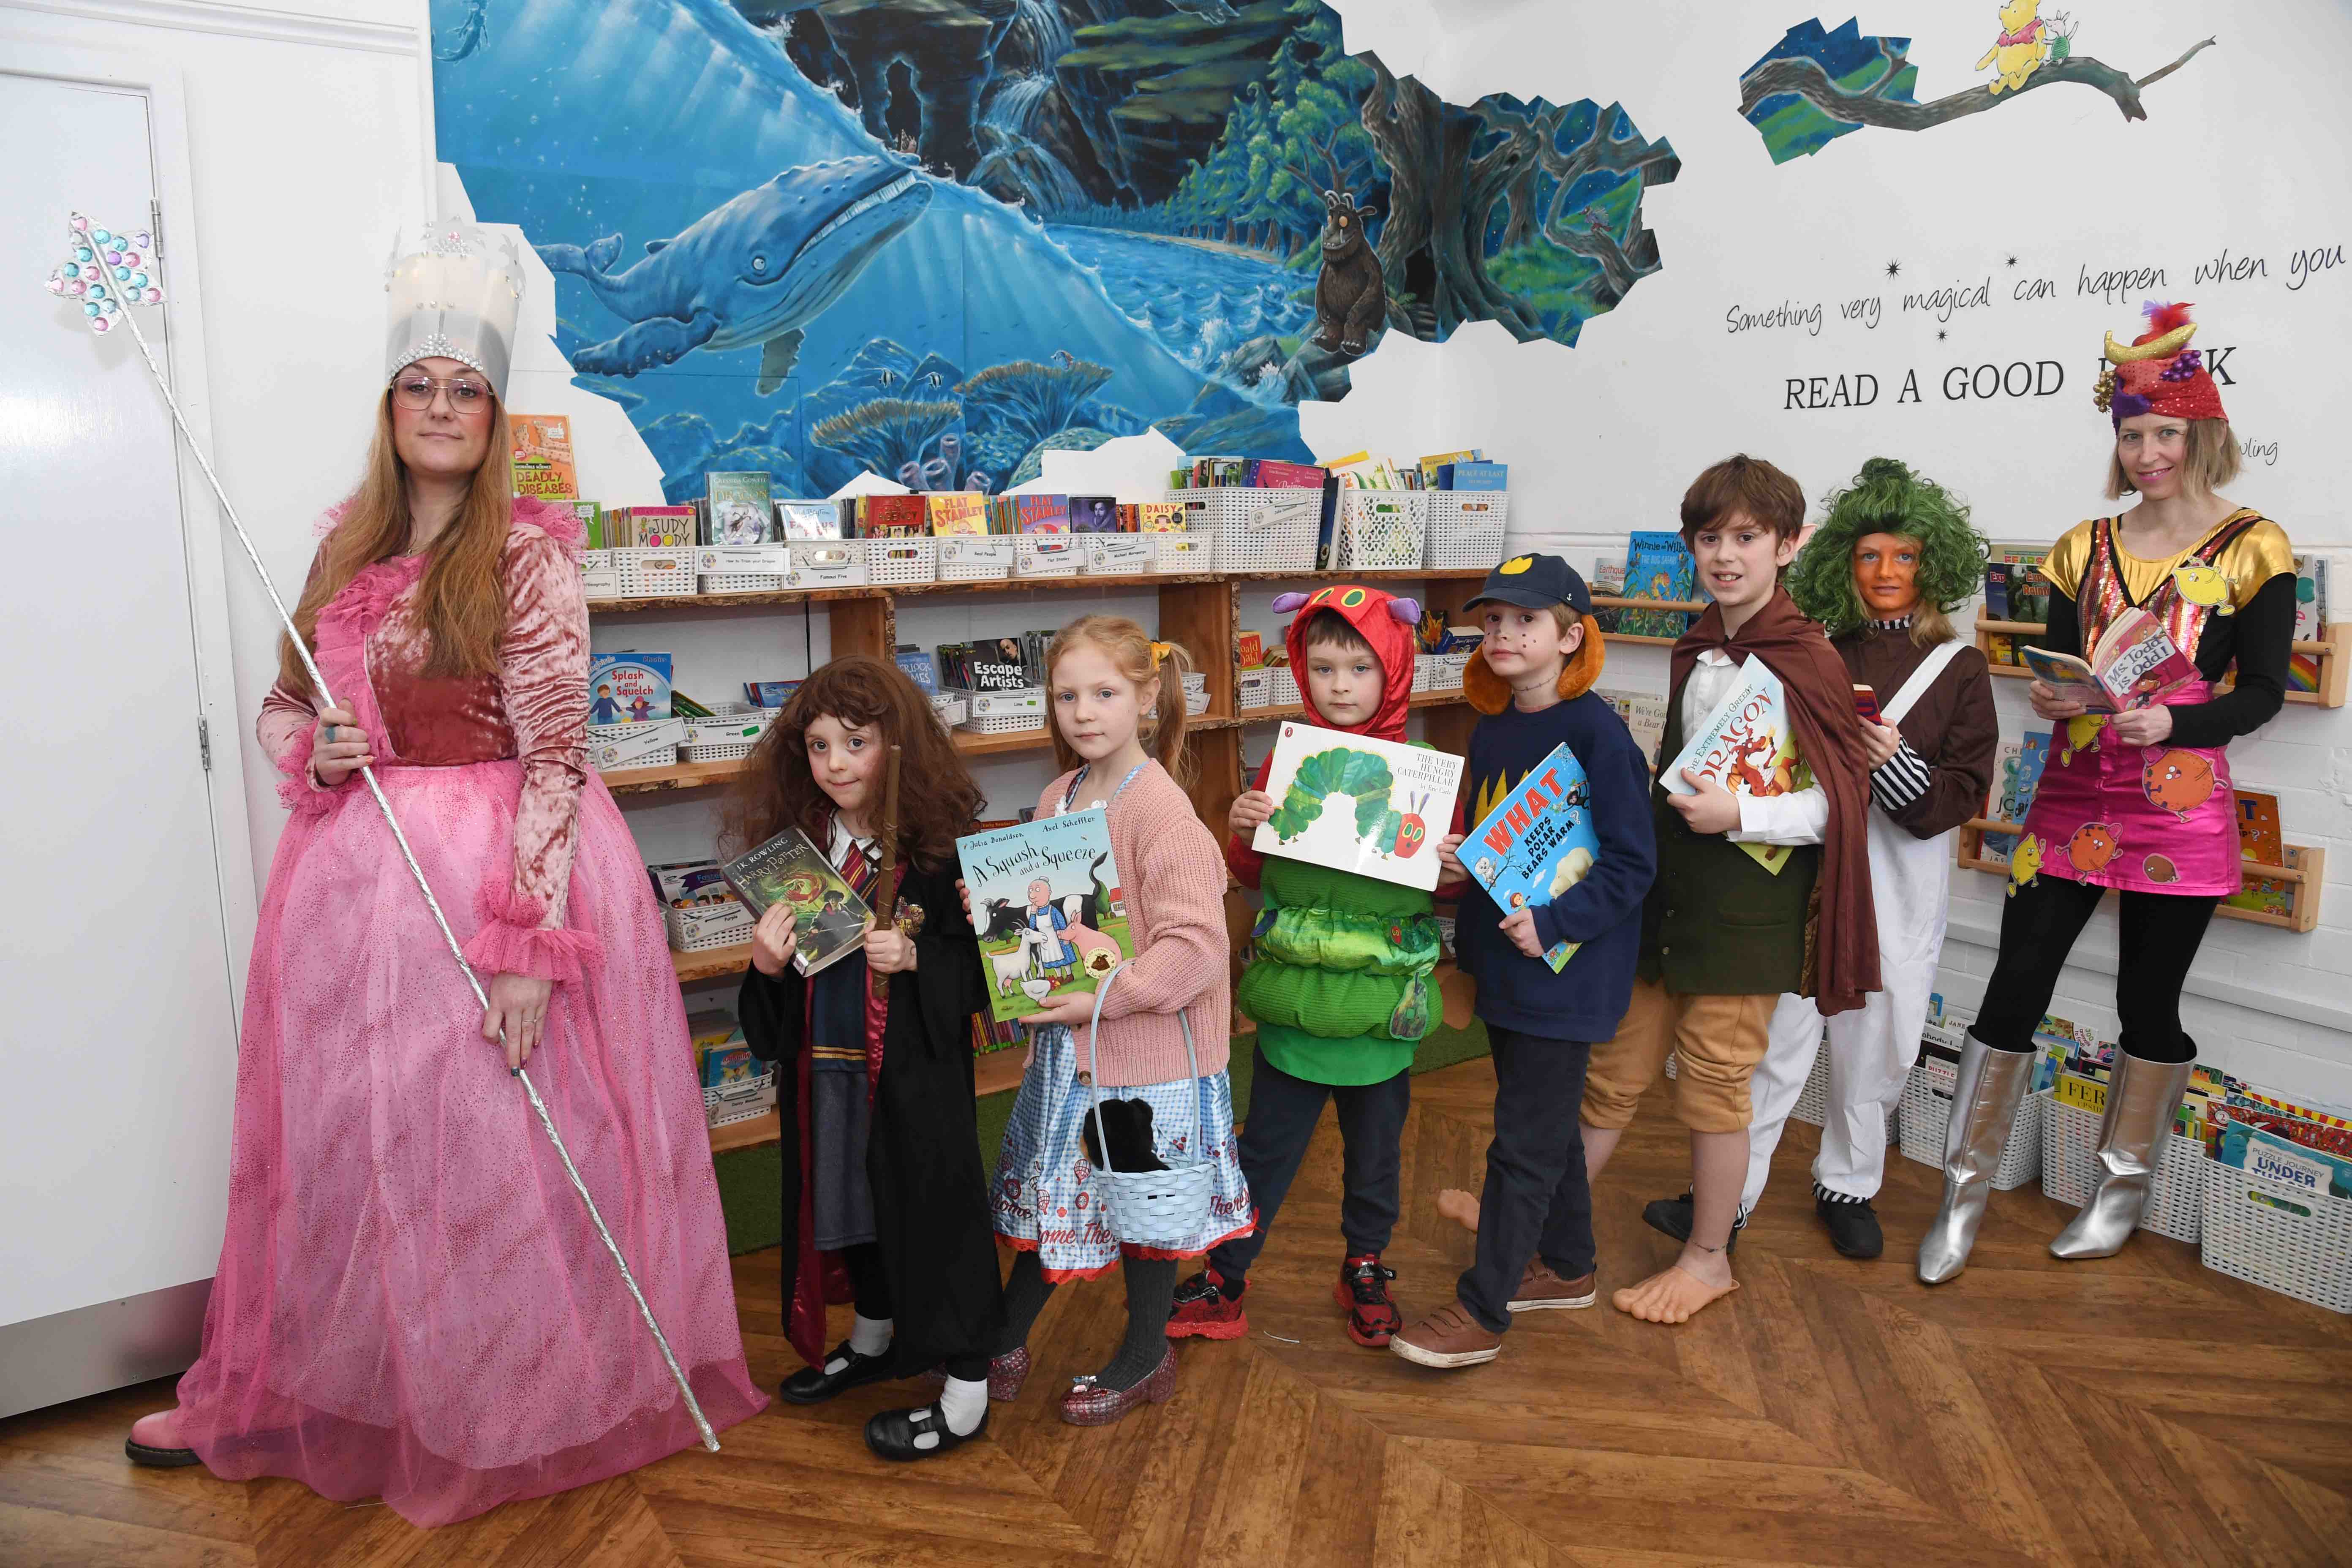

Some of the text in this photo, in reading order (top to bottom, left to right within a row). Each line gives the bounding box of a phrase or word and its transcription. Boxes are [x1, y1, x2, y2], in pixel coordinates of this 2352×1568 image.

[1726, 245, 2346, 336] Something very magical can happen when you
[1784, 373, 1878, 409] READ
[1897, 368, 1922, 403] A
[1943, 360, 2065, 400] GOOD
[516, 471, 562, 482] DEADLY
[517, 483, 573, 495] DISEASES
[944, 498, 967, 509] FLAT
[1030, 496, 1053, 507] FLAT
[1146, 504, 1177, 513] DAISY
[934, 506, 983, 527] STANLEY
[1021, 505, 1067, 525] STANLEY
[653, 518, 689, 534] JUDY
[639, 533, 690, 547] MOODY
[1665, 540, 1687, 553] Wilbu
[1599, 565, 1625, 574] Earthqua
[1240, 640, 1258, 653] oald
[2123, 634, 2161, 664] Todd
[611, 669, 644, 682] Splash
[973, 661, 1023, 676] Escape
[980, 675, 1024, 689] Artists
[616, 684, 653, 698] Squelch
[1636, 705, 1652, 716] We're
[1644, 719, 1661, 729] Bear
[1695, 711, 1730, 757] EXTREMELY
[1728, 683, 1754, 713] GREEDY
[644, 737, 659, 745] Yellow
[1699, 686, 1773, 784] DRAGON
[1416, 753, 1458, 770] THE VERY
[1396, 767, 1454, 787] CATERPILLAR
[1420, 764, 1455, 777] HUNGRY
[1428, 784, 1438, 792] Eric
[1482, 767, 1564, 857] WHAT
[969, 817, 1095, 850] Julia Donaldson Axel Scheffler
[1524, 816, 1551, 847] KEEPS
[1527, 825, 1555, 858] POLAR
[736, 836, 789, 872] J.K. ROWLING
[1019, 845, 1096, 877] and a Squeeze
[735, 864, 771, 890] HARRY
[767, 844, 809, 870] POTTER
[971, 840, 1040, 887] A Squash
[1521, 849, 1549, 880] BEARS
[2076, 1100, 2104, 1113] UPSID
[2219, 1113, 2226, 1121] 2
[2252, 1147, 2282, 1163] PUZZLE
[2284, 1159, 2325, 1179] JOURNEY
[2257, 1156, 2316, 1189] UNDER
